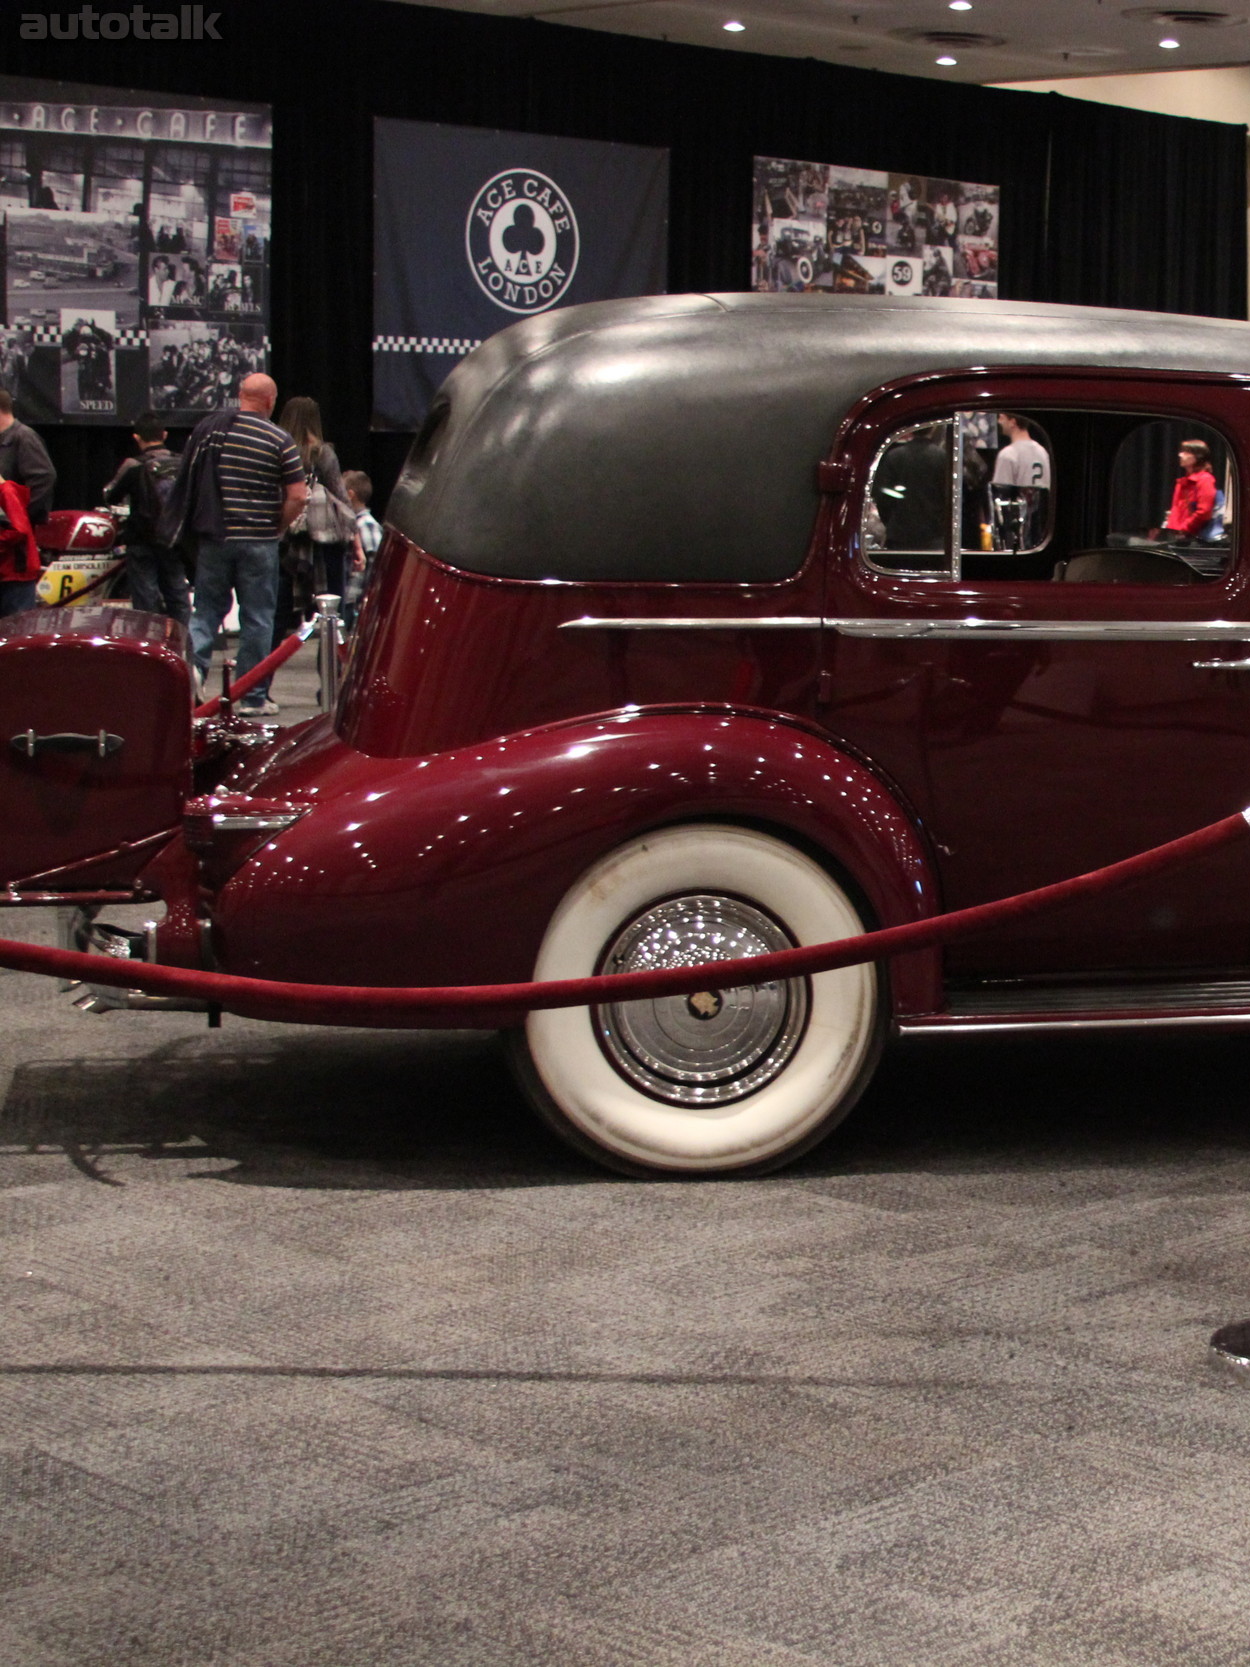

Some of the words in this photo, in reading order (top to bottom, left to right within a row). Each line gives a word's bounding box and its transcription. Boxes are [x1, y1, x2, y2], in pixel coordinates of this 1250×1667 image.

[136, 111, 247, 143] CAFE
[477, 179, 516, 226] ACE
[523, 179, 571, 233] CAFE
[504, 259, 543, 274] ACE
[893, 265, 911, 282] 59
[477, 256, 566, 304] LONDON
[79, 400, 114, 411] SPEED
[60, 574, 73, 600] 6
